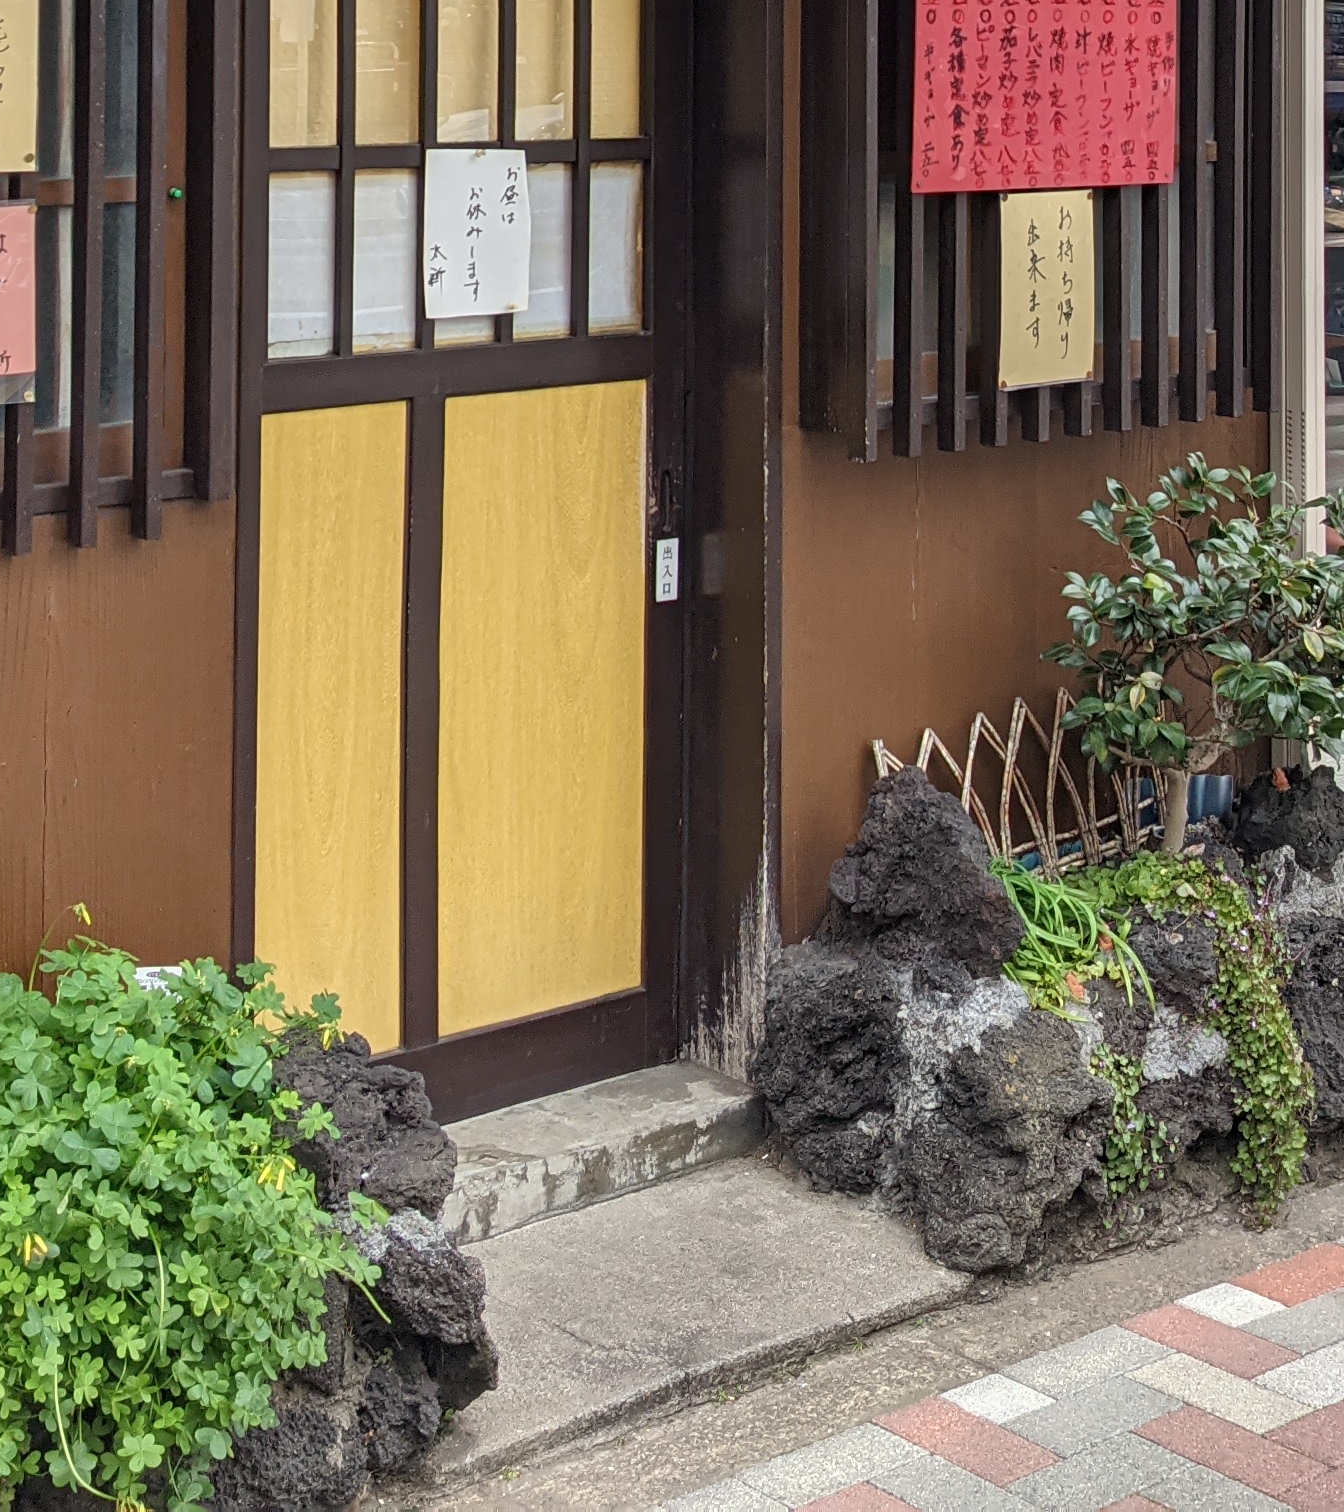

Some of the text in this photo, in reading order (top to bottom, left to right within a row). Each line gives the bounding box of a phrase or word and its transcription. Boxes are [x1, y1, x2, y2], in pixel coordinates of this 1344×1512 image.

[500, 167, 521, 224] お昼は
[1026, 219, 1046, 349] 出来ます
[1057, 206, 1074, 359] お持ち帰り
[662, 545, 673, 595] 出入口
